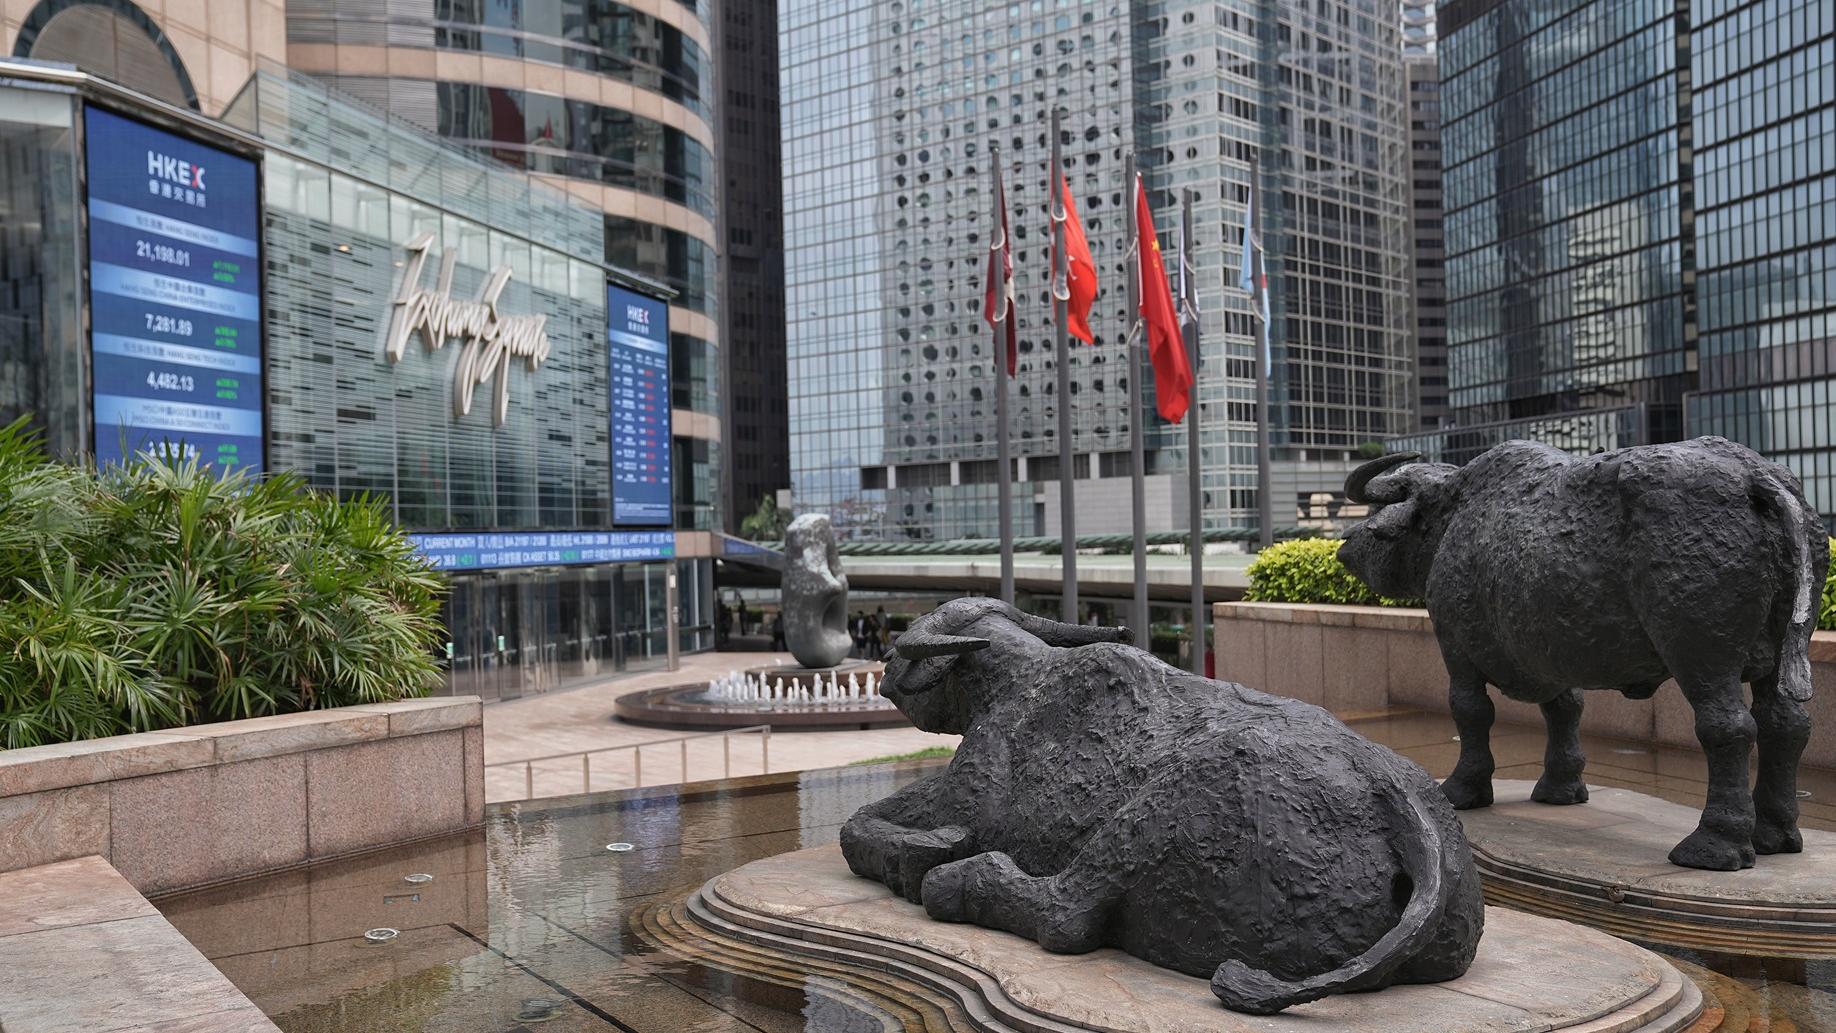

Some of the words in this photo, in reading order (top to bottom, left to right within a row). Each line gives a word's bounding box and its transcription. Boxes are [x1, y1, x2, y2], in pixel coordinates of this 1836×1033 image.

[147, 150, 206, 191] HKEX
[424, 537, 453, 549] CURRENT
[454, 536, 476, 548] MONTH
